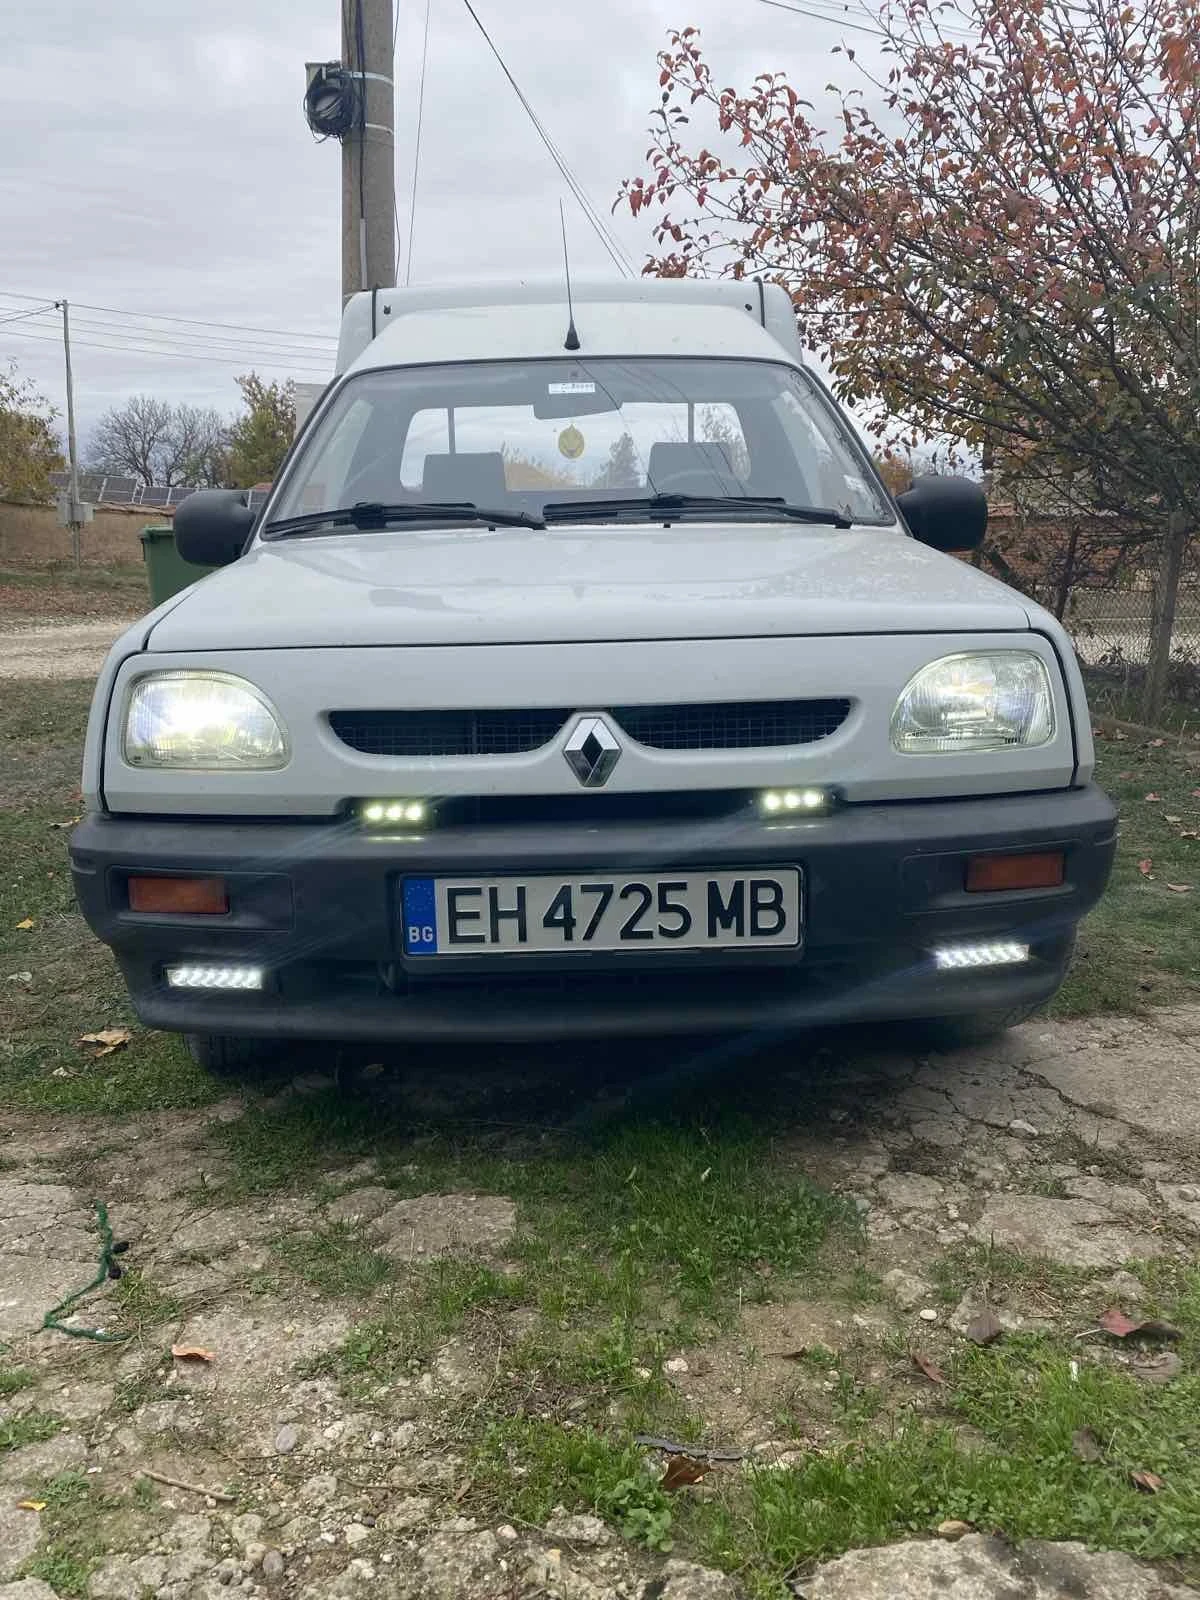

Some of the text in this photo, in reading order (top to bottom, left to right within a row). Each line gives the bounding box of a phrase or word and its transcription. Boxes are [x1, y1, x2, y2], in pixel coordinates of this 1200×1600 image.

[446, 879, 787, 944] EH 4725 MB
[408, 926, 433, 943] BG
